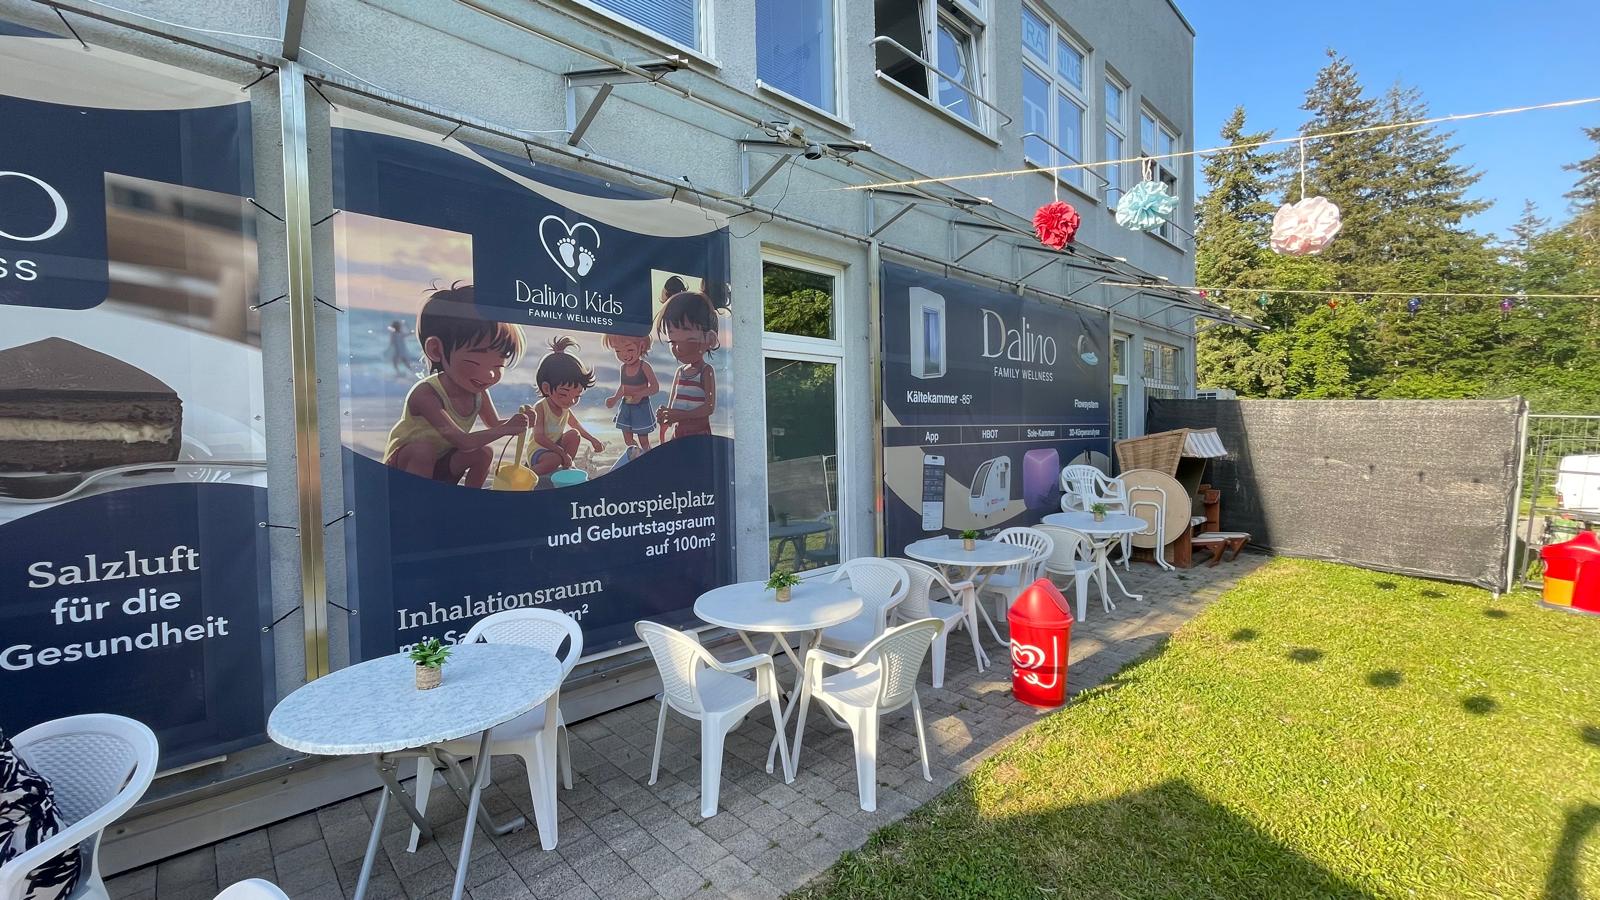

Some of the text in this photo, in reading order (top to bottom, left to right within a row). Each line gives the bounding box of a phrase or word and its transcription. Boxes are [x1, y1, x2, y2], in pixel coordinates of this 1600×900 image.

[516, 280, 623, 315] Dalino Kids
[528, 308, 613, 326] FAMILY WELLNESS
[980, 308, 1057, 366] Dalino
[993, 366, 1053, 382] FAMILY WELLNESS
[906, 390, 958, 404] Kältekammer
[925, 431, 940, 443] App
[982, 429, 999, 439] HBOT
[570, 491, 715, 520] Indoorspielplatz
[548, 516, 715, 547] und Geburtstagsraum
[645, 539, 670, 557] auf
[28, 545, 200, 589] Salzluft
[51, 588, 181, 625] für die
[397, 579, 604, 631] Inhalationsraum
[0, 615, 229, 671] Gesundheit
